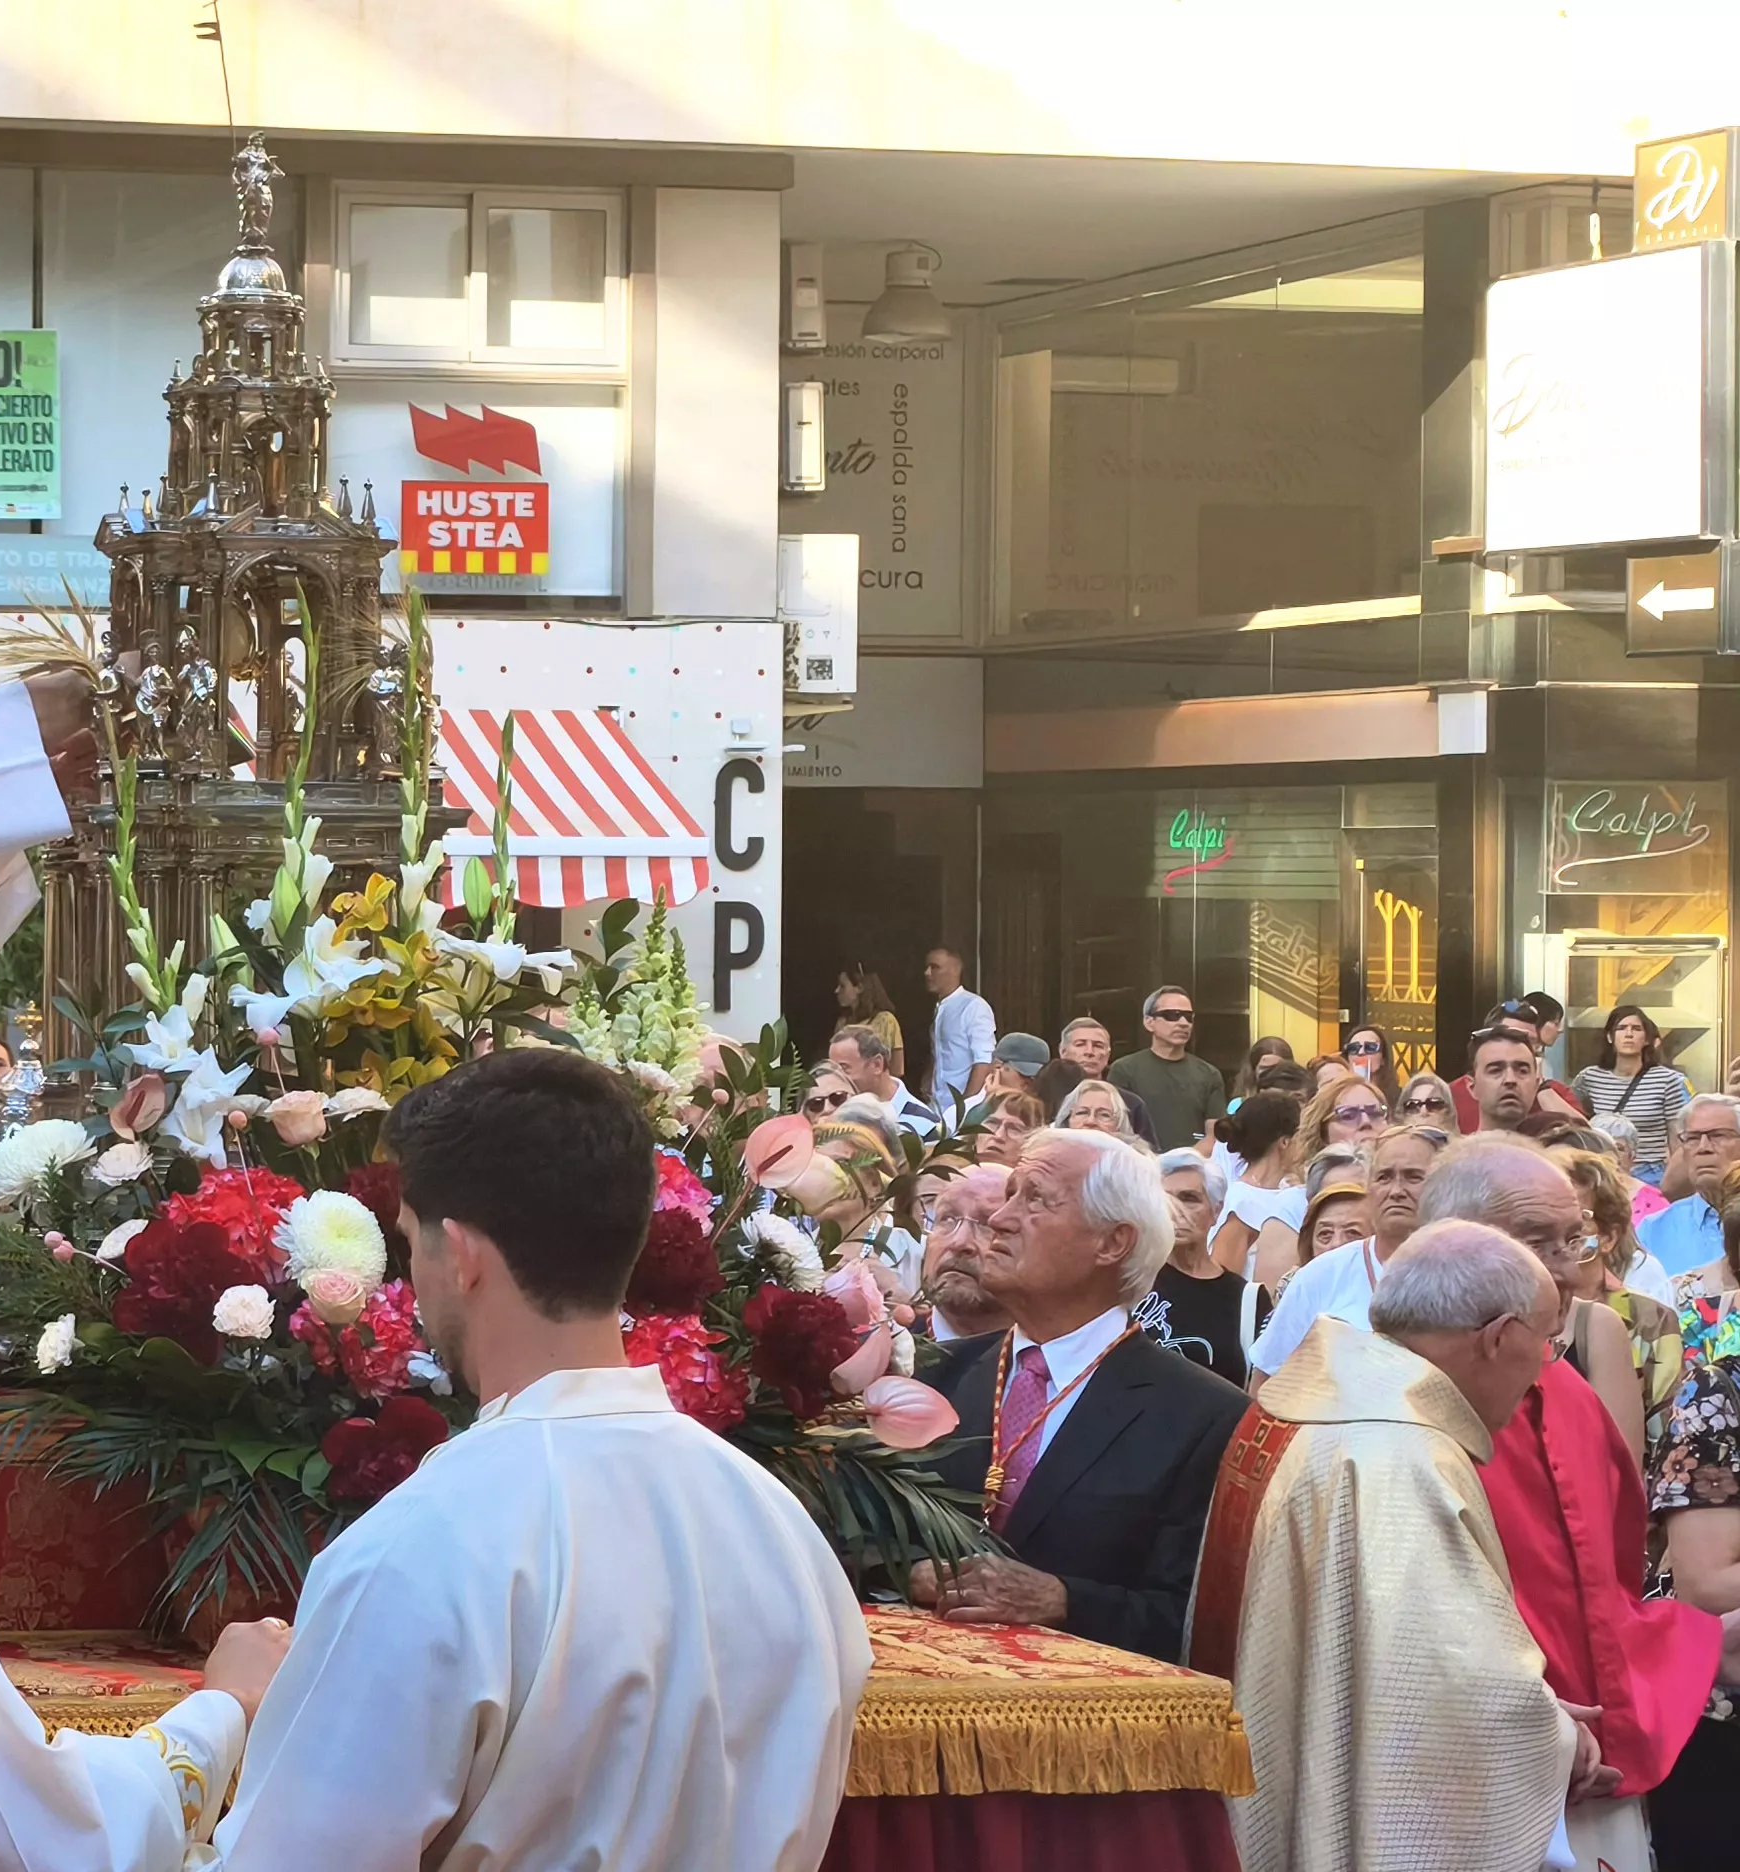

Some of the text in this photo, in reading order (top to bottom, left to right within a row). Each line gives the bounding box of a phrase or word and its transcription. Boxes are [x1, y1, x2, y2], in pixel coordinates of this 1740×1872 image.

[871, 343, 945, 361] corporal
[32, 422, 53, 444] EN
[890, 383, 914, 553] espalda sana
[417, 490, 535, 517] HUSTE
[427, 520, 525, 548] STEA
[28, 551, 58, 568] DE
[1169, 808, 1227, 862] Calpi
